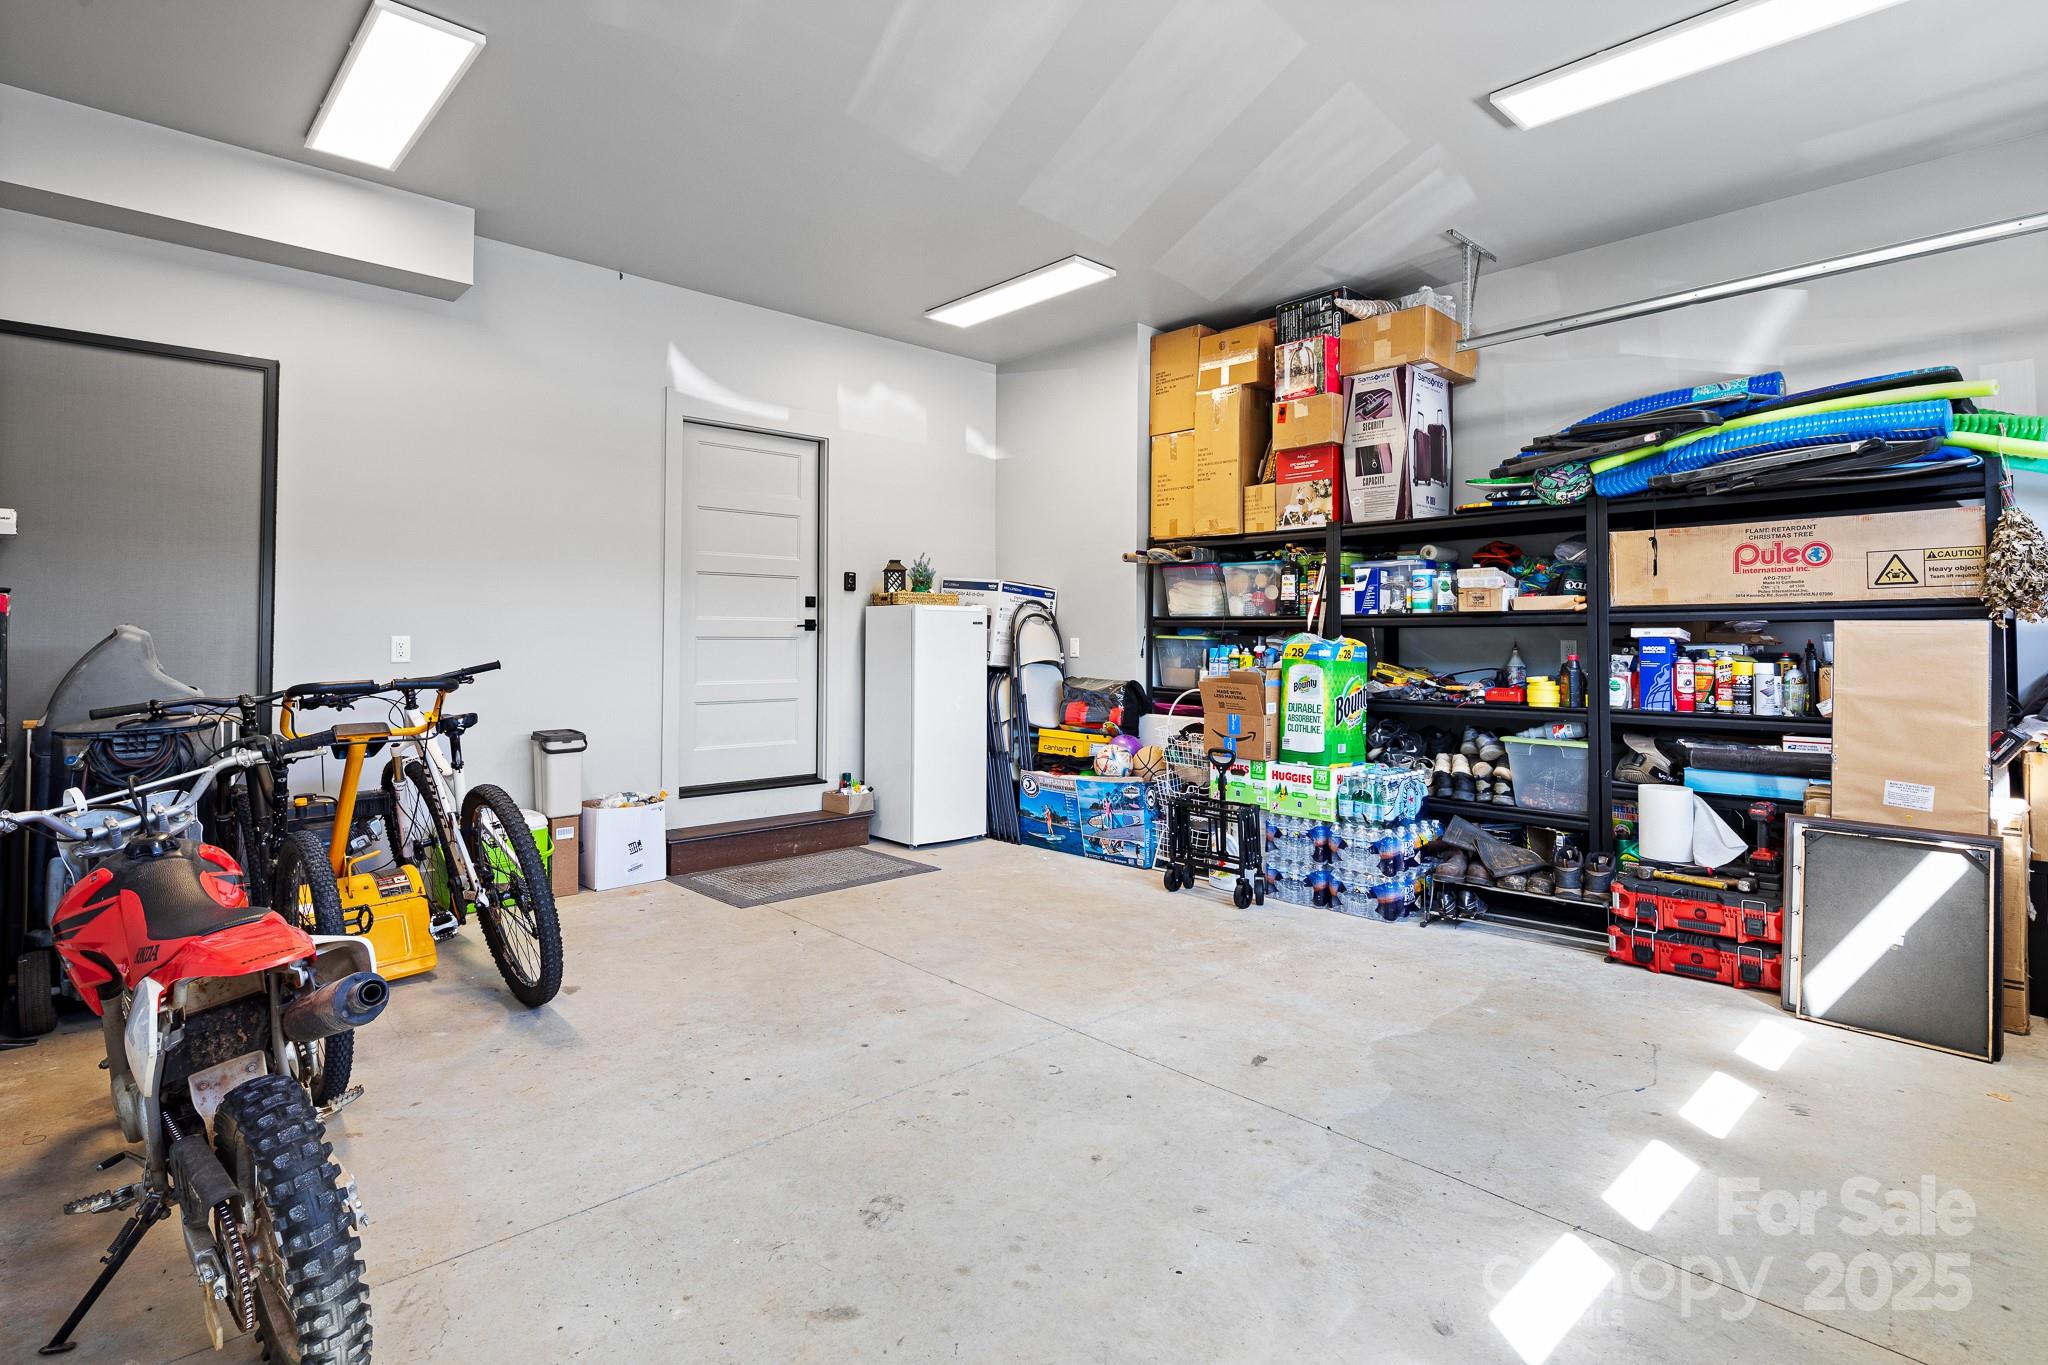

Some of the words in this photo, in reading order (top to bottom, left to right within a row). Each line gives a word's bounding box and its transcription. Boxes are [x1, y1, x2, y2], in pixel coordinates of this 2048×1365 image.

[1357, 372, 1391, 384] Samsonite
[1417, 372, 1444, 390] Samsonite
[1362, 420, 1385, 432] SECURITY
[1362, 475, 1385, 487] CAPACITY
[1771, 524, 1817, 533] RETARDANT
[1748, 532, 1792, 540] CHRISTMAS
[1937, 549, 1982, 558] CAUTION
[1742, 566, 1794, 574] International
[1928, 565, 1953, 573] Heavy
[1954, 564, 1980, 572] object
[1291, 647, 1304, 657] 28
[1343, 649, 1352, 659] 28
[1293, 679, 1317, 692] Bounty
[1335, 686, 1368, 726] Bount
[1271, 770, 1312, 785] HUGGIES
